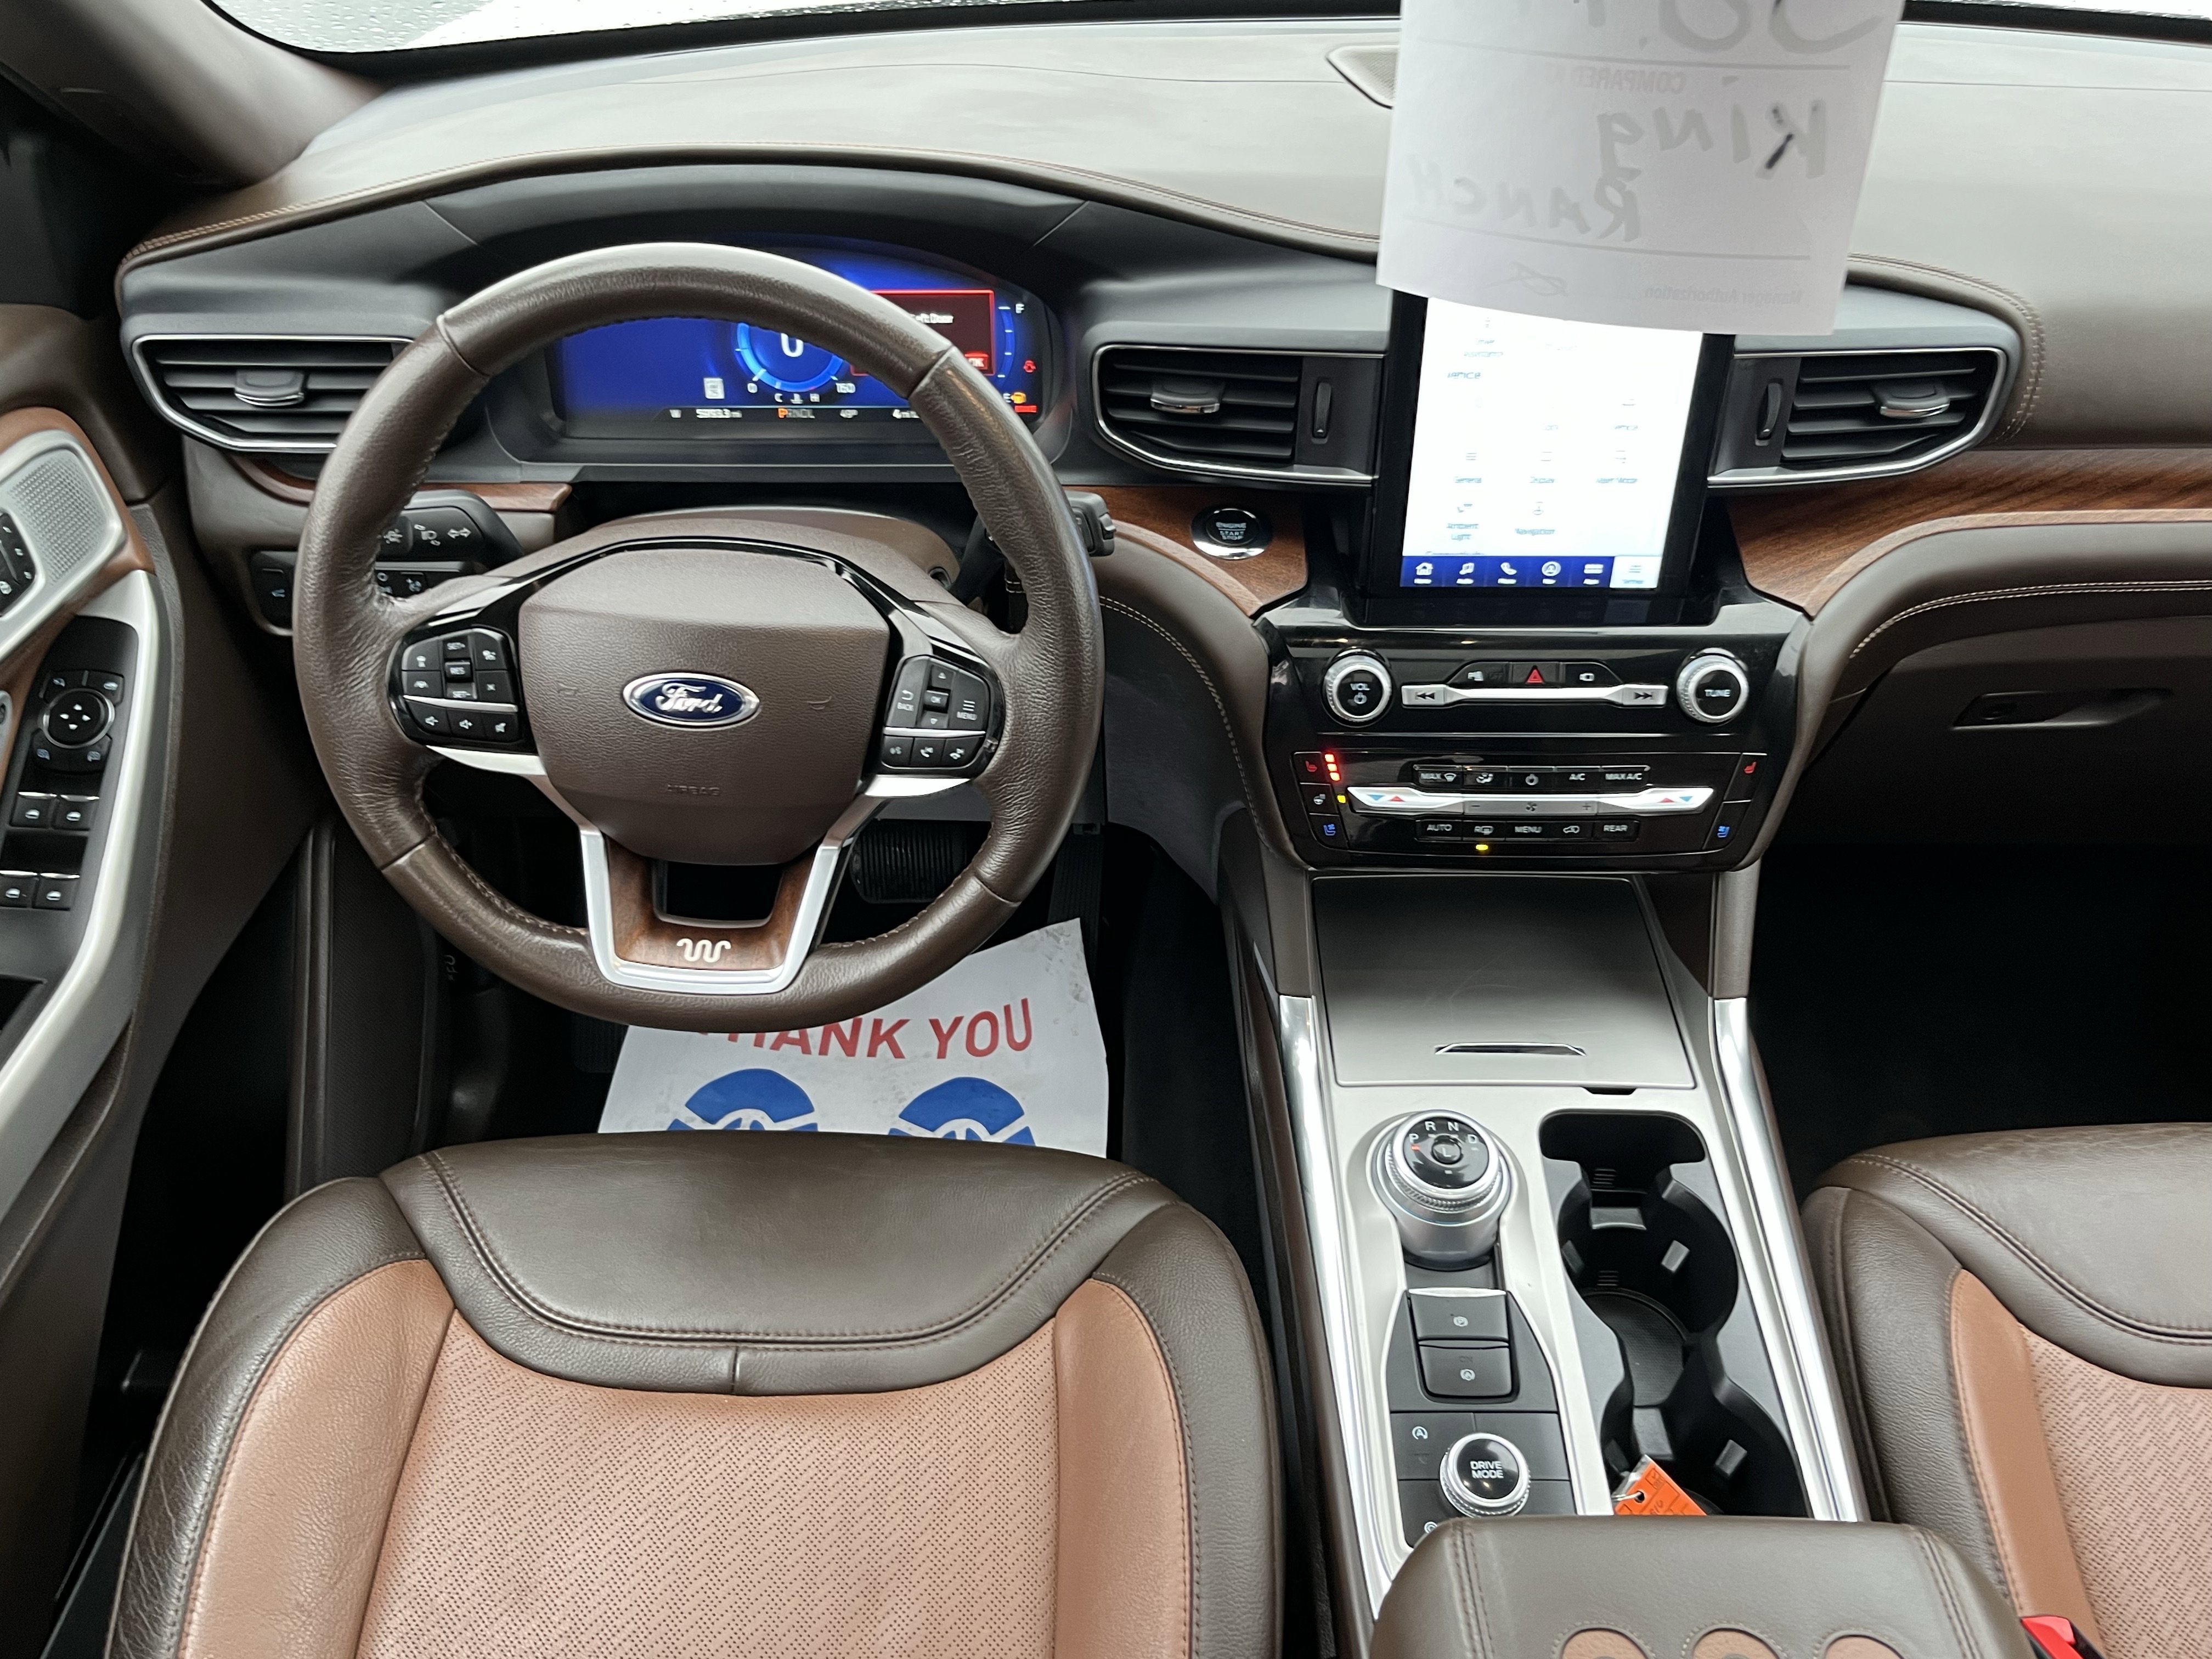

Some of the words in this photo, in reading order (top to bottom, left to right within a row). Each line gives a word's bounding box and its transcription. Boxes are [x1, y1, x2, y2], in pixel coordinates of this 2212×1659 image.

[654, 682, 724, 713] Ford
[1705, 689, 1731, 697] TUNE
[699, 1017, 911, 1059] ANK
[929, 998, 1034, 1059] YOU
[1425, 1121, 1436, 1131] R
[1447, 1121, 1459, 1131] N
[1409, 1133, 1419, 1143] P
[1468, 1133, 1478, 1143] D
[1441, 1147, 1452, 1158] L
[1470, 1460, 1503, 1470] DRIVE
[1471, 1470, 1504, 1479] MODE
